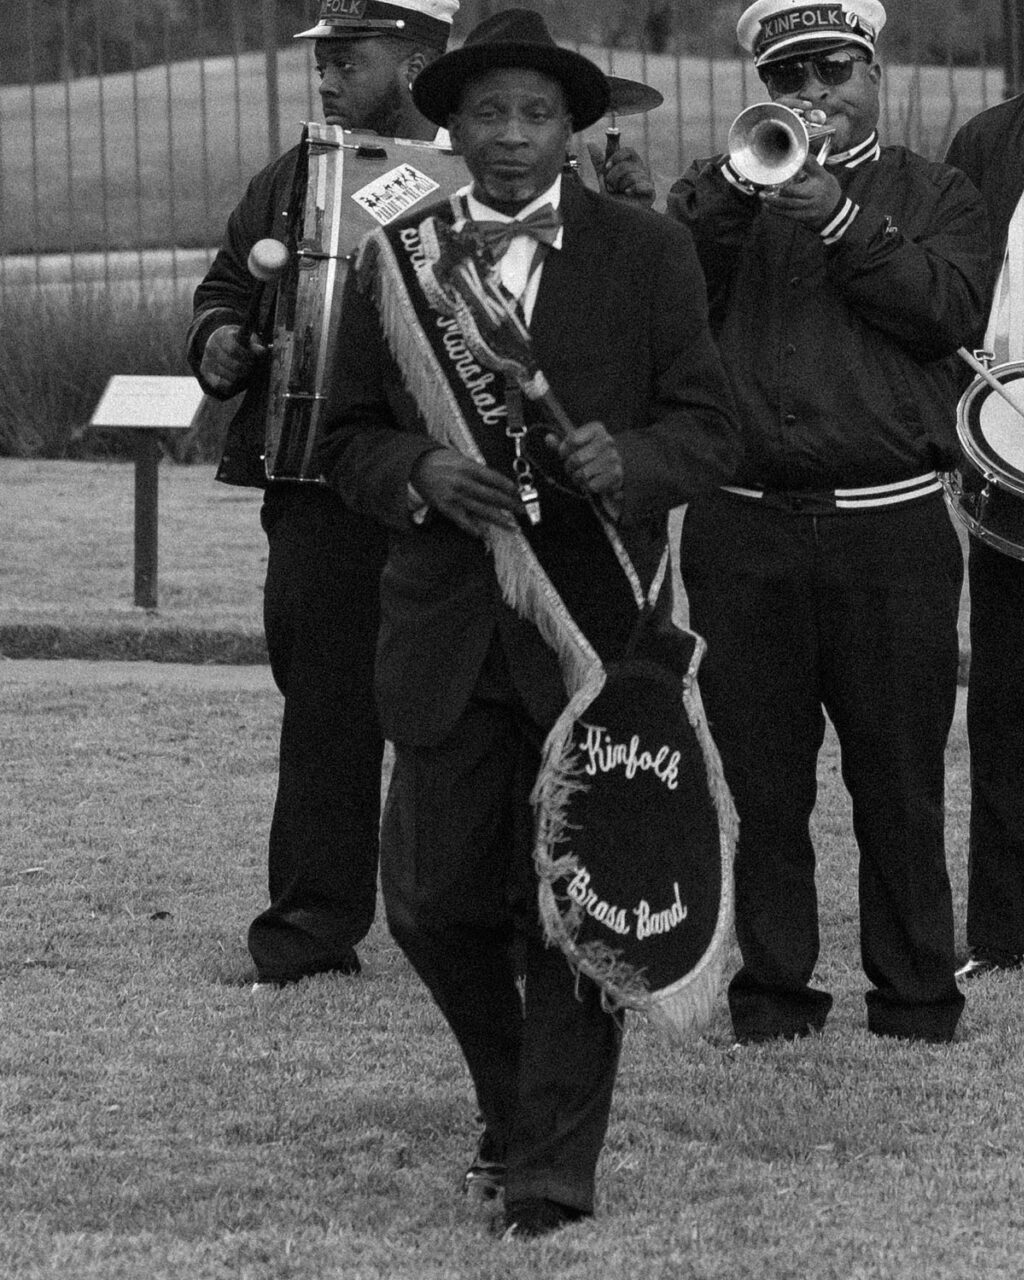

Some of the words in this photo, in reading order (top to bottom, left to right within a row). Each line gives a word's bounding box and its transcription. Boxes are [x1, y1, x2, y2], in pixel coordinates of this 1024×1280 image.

[764, 10, 840, 38] KINFOLK
[437, 316, 508, 425] Marshal
[579, 726, 681, 790] Kinfolk
[567, 867, 630, 934] Brass
[633, 881, 687, 940] Band
